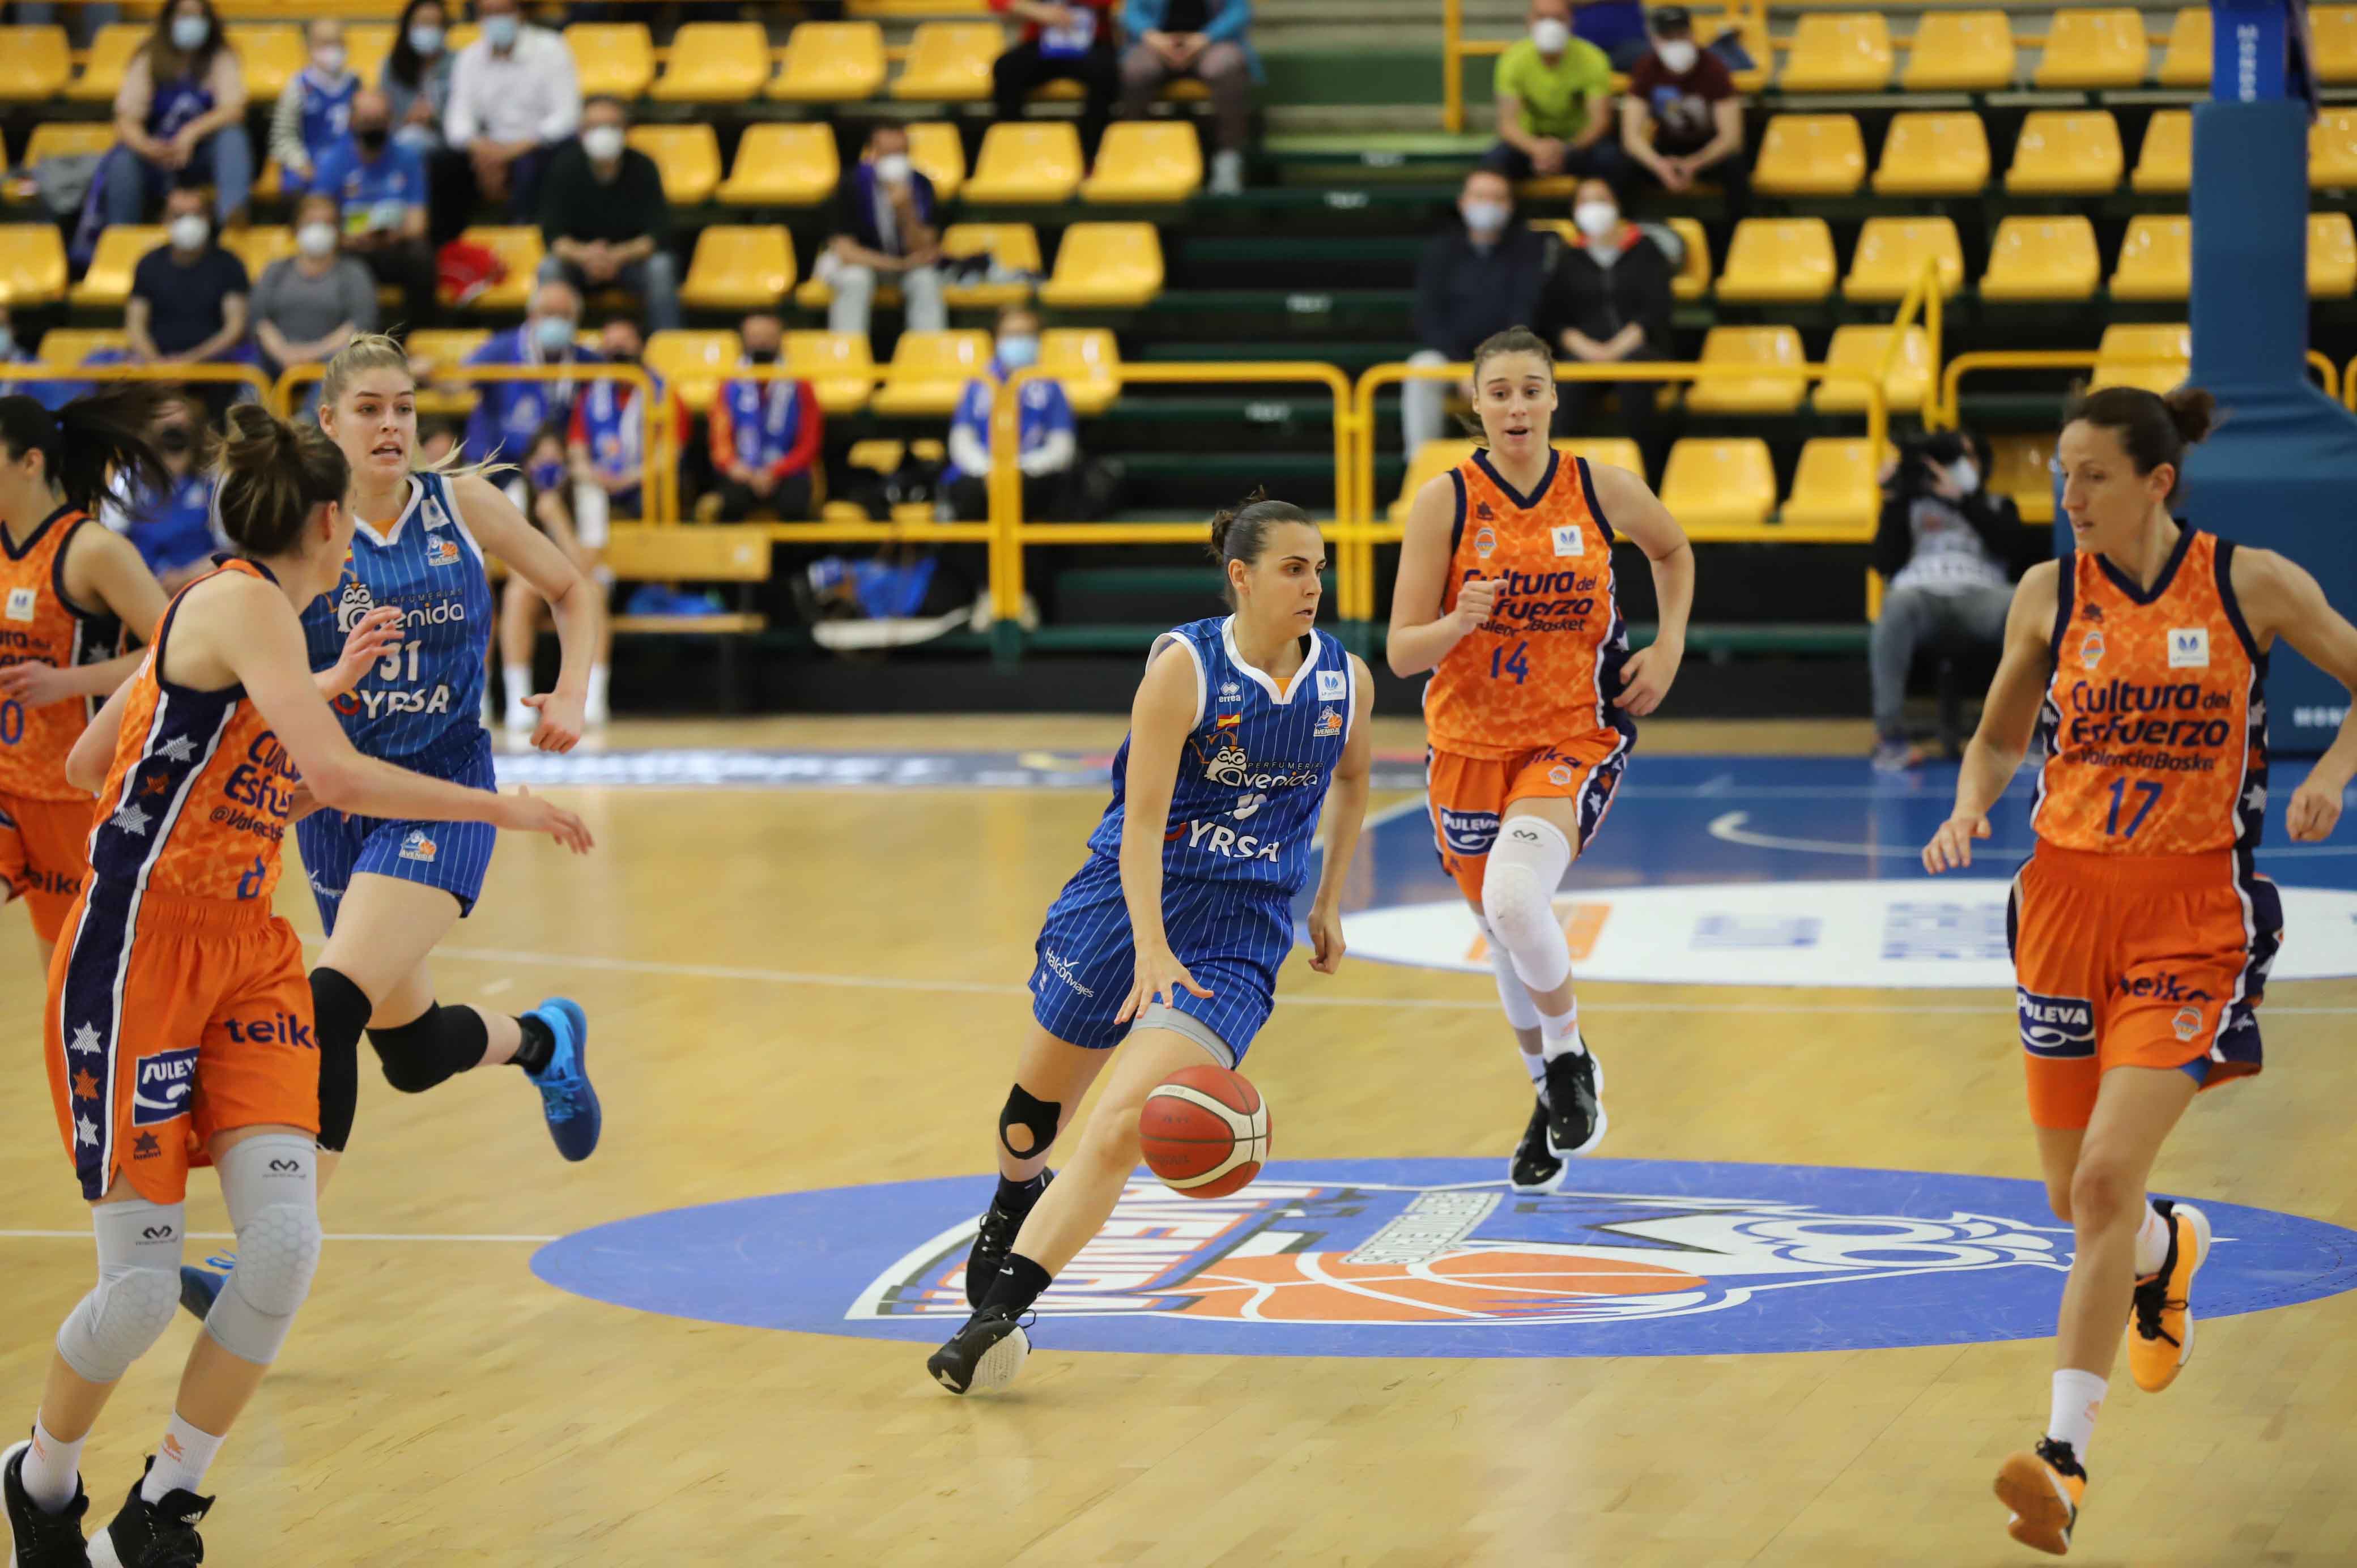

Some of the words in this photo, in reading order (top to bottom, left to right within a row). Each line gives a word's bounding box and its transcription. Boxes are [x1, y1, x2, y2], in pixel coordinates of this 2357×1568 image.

[1576, 576, 1597, 591] del
[380, 640, 422, 681] 31
[1491, 641, 1528, 684] 14
[2073, 679, 2200, 713] Cultura
[2203, 691, 2231, 709] del
[2106, 776, 2163, 838] 17
[1069, 978, 1094, 998] viajes
[2017, 992, 2089, 1025] PULEVA
[224, 1012, 321, 1049] teik
